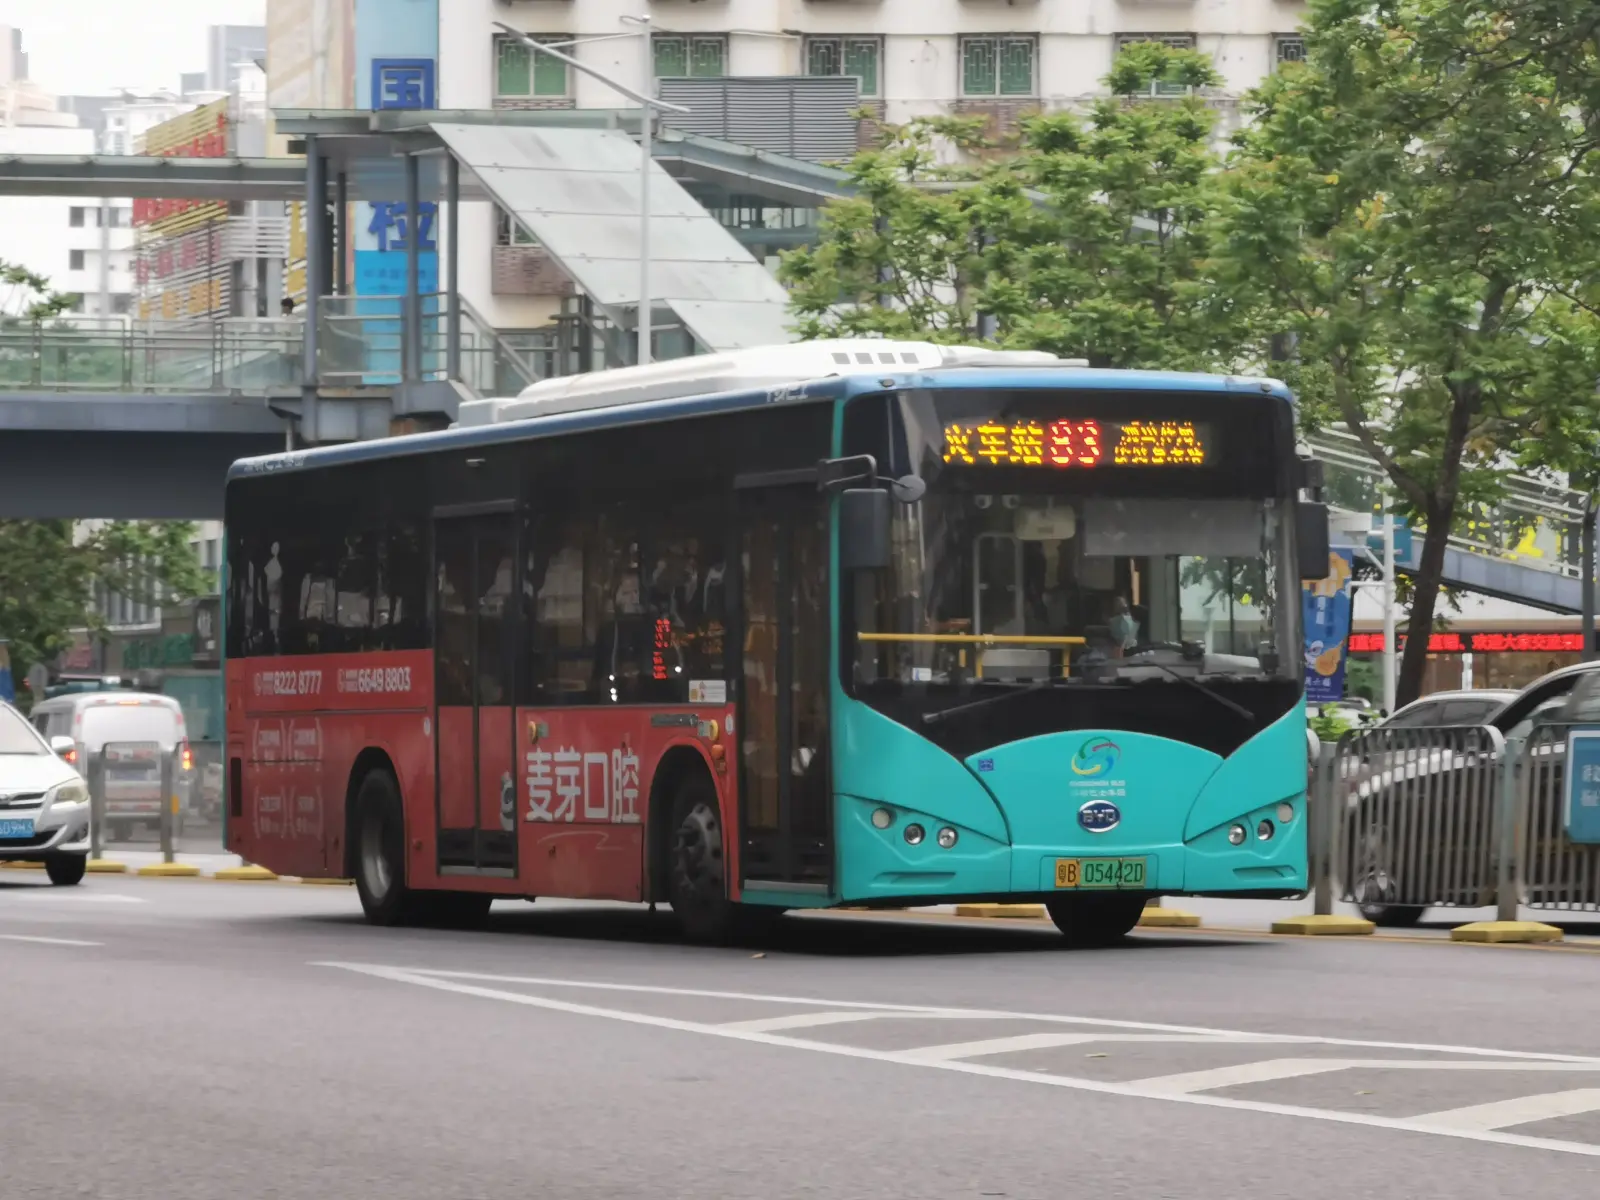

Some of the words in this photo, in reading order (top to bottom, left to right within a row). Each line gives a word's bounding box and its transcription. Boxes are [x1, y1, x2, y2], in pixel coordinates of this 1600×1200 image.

[1050, 420, 1100, 465] 83
[526, 745, 640, 823] 麦芽口腔
[1082, 808, 1116, 823] BYD
